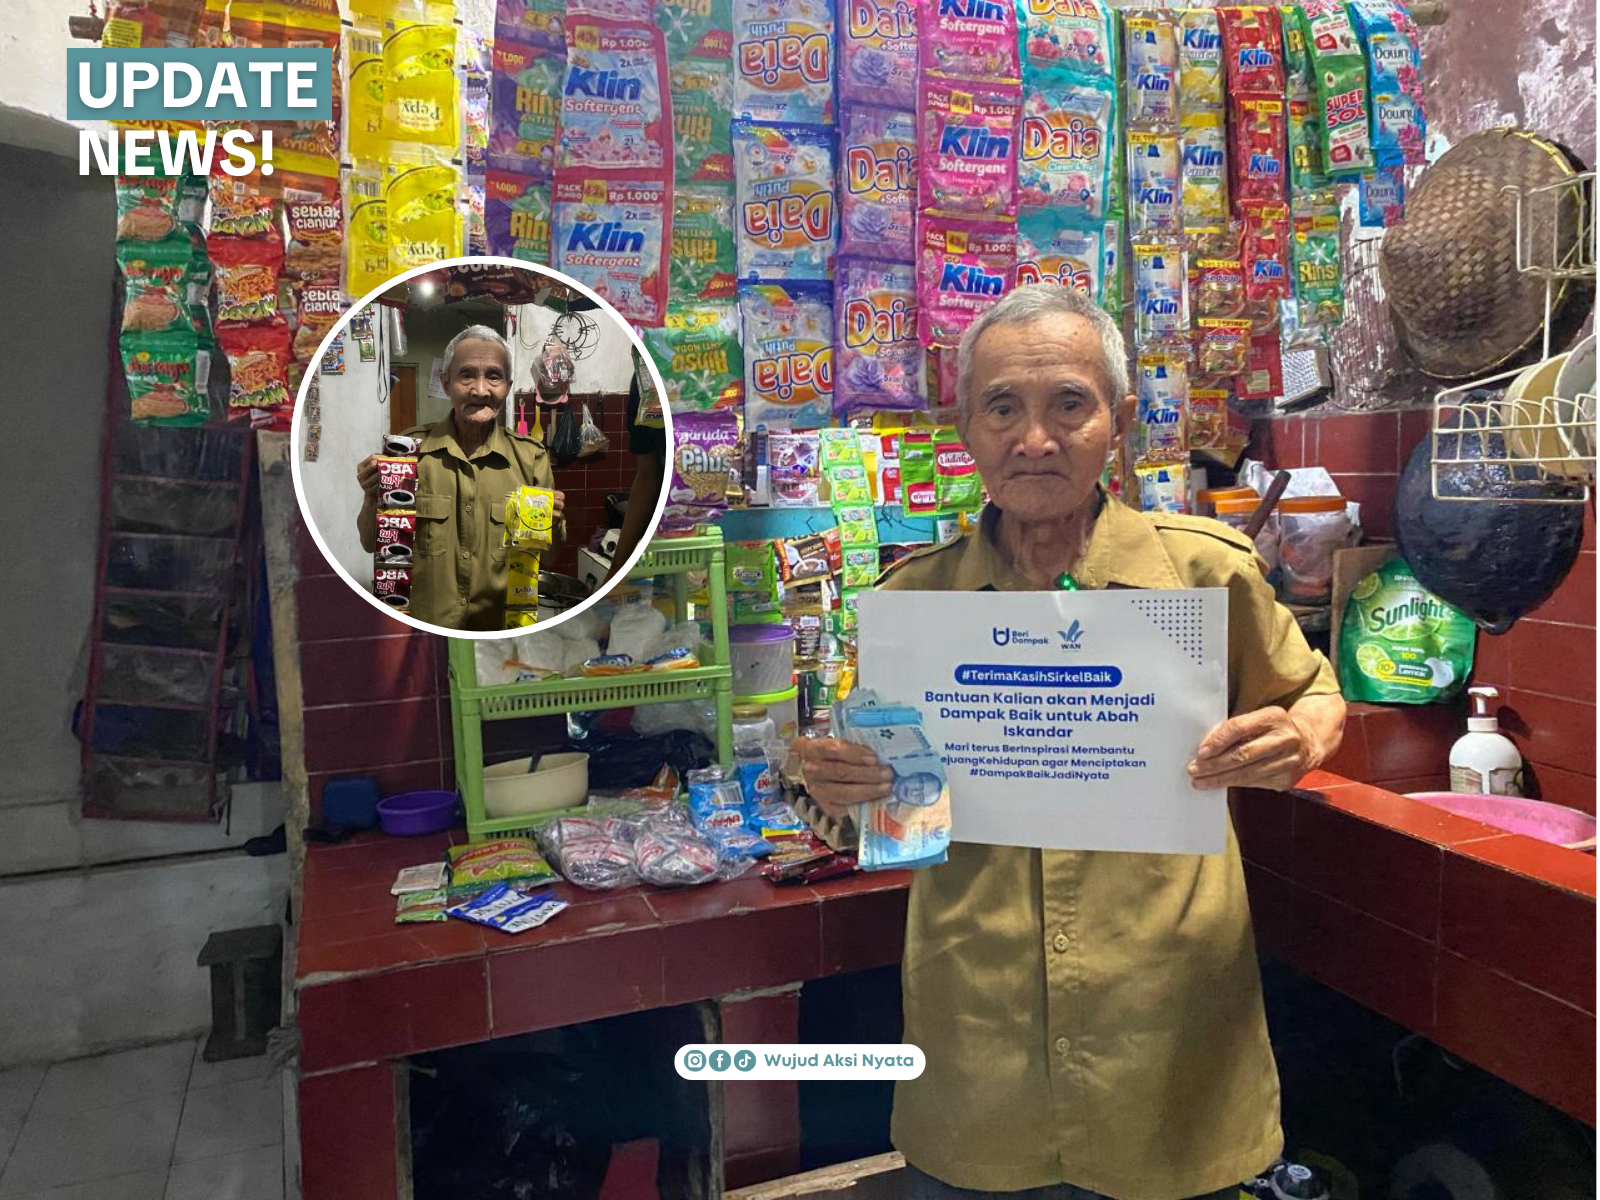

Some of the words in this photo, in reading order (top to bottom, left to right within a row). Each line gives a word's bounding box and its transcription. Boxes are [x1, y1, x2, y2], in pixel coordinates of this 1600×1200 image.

[939, 0, 1004, 22] Klin
[750, 21, 787, 37] Putih
[939, 18, 1006, 36] Softergent
[602, 38, 617, 48] Rp
[1183, 28, 1222, 49] Klin
[739, 34, 829, 84] Daia
[1239, 49, 1273, 67] Klin
[1374, 46, 1413, 62] Downy
[564, 67, 642, 101] Klin
[1137, 75, 1170, 91] Klin
[516, 86, 561, 117] Rins
[565, 99, 642, 117] Softergent
[974, 104, 988, 115] Rp
[1326, 89, 1365, 113] SUPER
[401, 100, 440, 121] Pepy
[1326, 104, 1367, 128] SOL
[1378, 105, 1417, 122] Downy
[675, 116, 712, 142] Rin
[939, 124, 1011, 160] Klin
[1021, 116, 1101, 162] Daia
[1183, 145, 1223, 166] Klin
[1249, 154, 1280, 175] Klin
[938, 158, 1008, 175] Softergent
[557, 184, 582, 192] PACK
[609, 191, 624, 202] Rp
[627, 191, 659, 201] 1.000
[753, 179, 790, 197] Putih
[1140, 188, 1173, 205] Klin
[292, 205, 341, 219] seblak
[625, 210, 638, 220] 2x
[744, 191, 834, 244] Daia
[296, 217, 338, 230] cianjur
[510, 210, 549, 240] Rin
[567, 221, 645, 252] Klin
[671, 238, 718, 265] Rins
[566, 253, 640, 269] Softergent
[1254, 260, 1283, 279] Klin
[938, 262, 1005, 296] Klin
[302, 290, 340, 301] sebla
[304, 300, 340, 313] cianju
[1145, 299, 1178, 315] Klin
[759, 340, 796, 352] Putih
[671, 350, 729, 375] Rinso
[753, 346, 834, 400] Daia
[1146, 408, 1180, 425] Klin
[676, 428, 731, 445] garuda
[681, 448, 731, 474] Pilus
[1369, 597, 1445, 634] Sunlight
[1011, 637, 1049, 646] Dampak
[962, 669, 1112, 684] #TerimaKasihSirkelBaik
[925, 691, 990, 704] Bantuan
[993, 692, 1043, 705] Kalian
[1047, 694, 1087, 706] akan
[1091, 693, 1155, 709] Menjadi
[940, 707, 1006, 722] Dampak
[1009, 708, 1043, 721] Baik
[1046, 710, 1093, 722] untuk
[1096, 710, 1139, 722] Abah
[1003, 725, 1074, 738] Iskandar
[944, 743, 970, 752] Mari
[971, 743, 1000, 753] terus
[1002, 744, 1070, 756] BerInspirasi
[1071, 745, 1135, 755] Membantu
[940, 755, 1040, 768] ejuangKehidupan
[1041, 758, 1069, 769] agar
[1070, 758, 1147, 769] Menciptakan
[969, 768, 1110, 781] #DampakBaikJadiNyata
